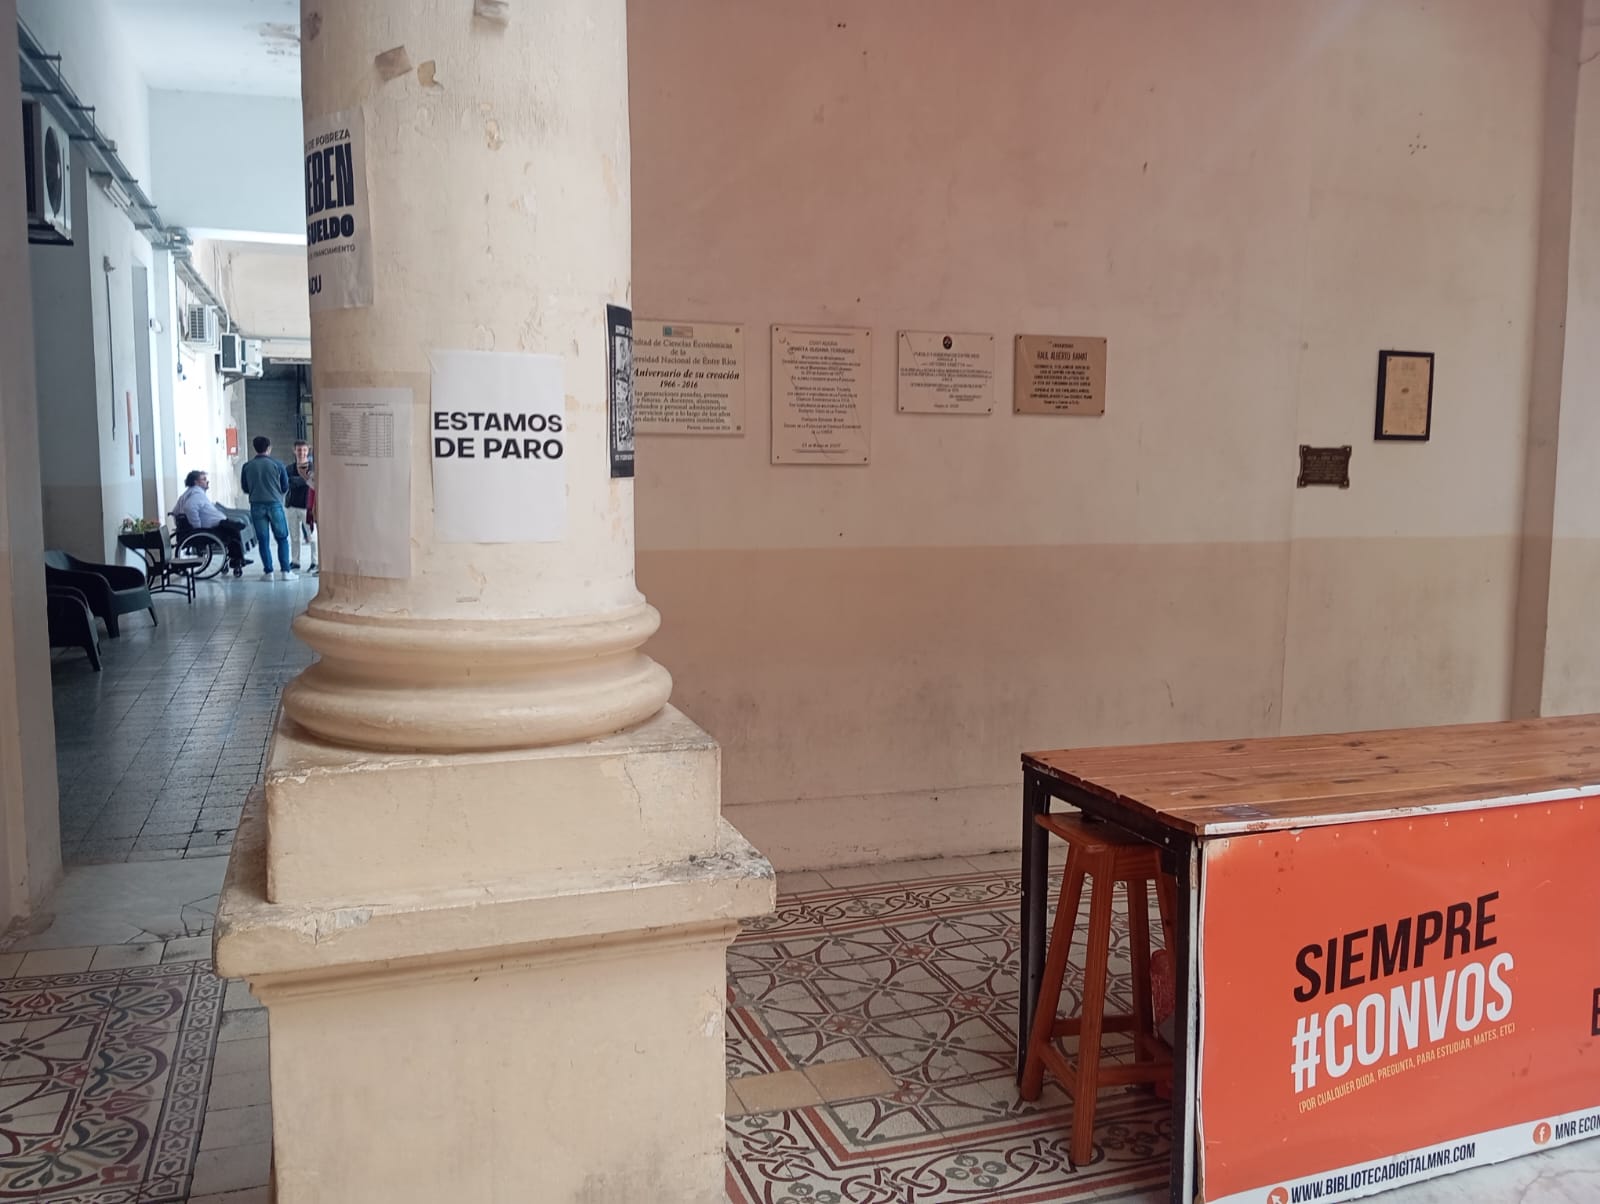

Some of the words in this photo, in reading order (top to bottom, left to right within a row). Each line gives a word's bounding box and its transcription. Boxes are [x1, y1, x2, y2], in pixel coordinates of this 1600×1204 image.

[316, 128, 350, 146] POBREZA
[634, 367, 681, 378] Aniversario
[683, 369, 693, 378] de
[694, 371, 704, 379] su
[706, 370, 740, 380] creación
[660, 380, 676, 389] 1966
[682, 380, 698, 389] 2016
[434, 411, 563, 433] ESTAMOS
[434, 437, 475, 458] DE
[483, 437, 563, 460] PARO
[1293, 890, 1499, 1003] SIEMPRE
[1290, 951, 1515, 1093] #CONVOS
[1299, 1096, 1317, 1114] (POR
[1318, 1080, 1355, 1106] CUALQUIER
[1377, 1057, 1416, 1080] PREGUNTA,
[1416, 1051, 1436, 1068] PARA
[1500, 1022, 1516, 1037] ETC)
[1555, 1120, 1577, 1140] MNR
[1291, 1142, 1476, 1203] WWW.BIBLIOTECADIGITALMNR.COM
